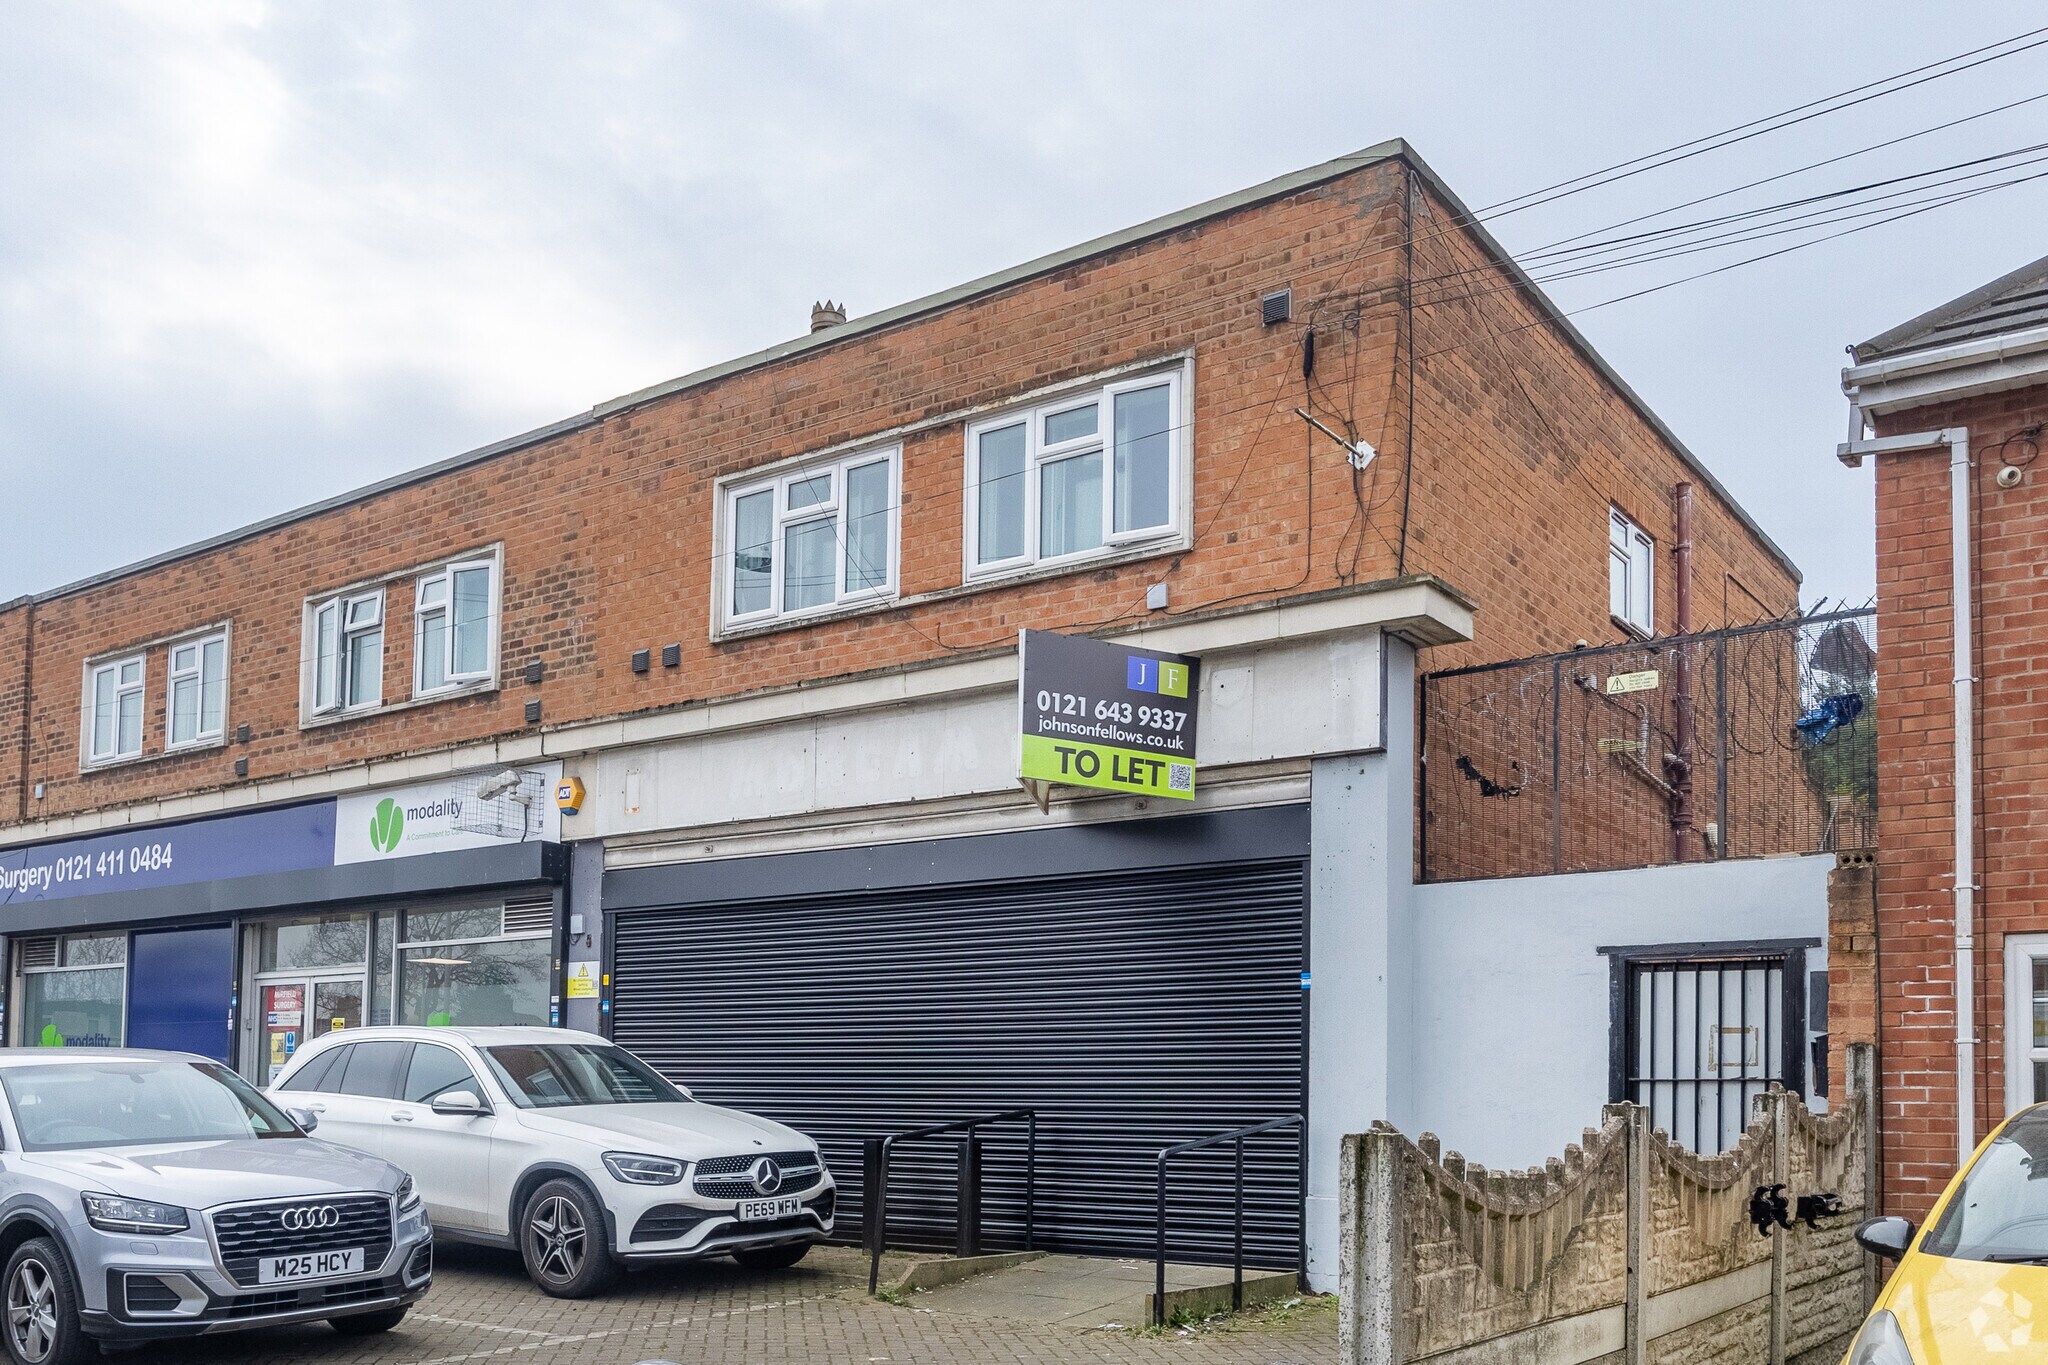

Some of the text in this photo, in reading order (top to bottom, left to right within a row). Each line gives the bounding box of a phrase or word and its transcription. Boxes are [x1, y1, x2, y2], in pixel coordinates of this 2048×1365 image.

[1036, 690, 1188, 732] 0121 643 9337
[1038, 714, 1185, 750] johnsonfellows.co.uk
[1054, 745, 1166, 787] TO LET
[559, 787, 570, 798] ADT
[407, 798, 463, 821] modality
[55, 854, 91, 883] 0121
[96, 849, 124, 877] 411
[130, 842, 173, 873] 0484
[66, 1033, 110, 1047] modality
[745, 1199, 798, 1218] PE69 WFM
[274, 1251, 352, 1278] M25 HCY
